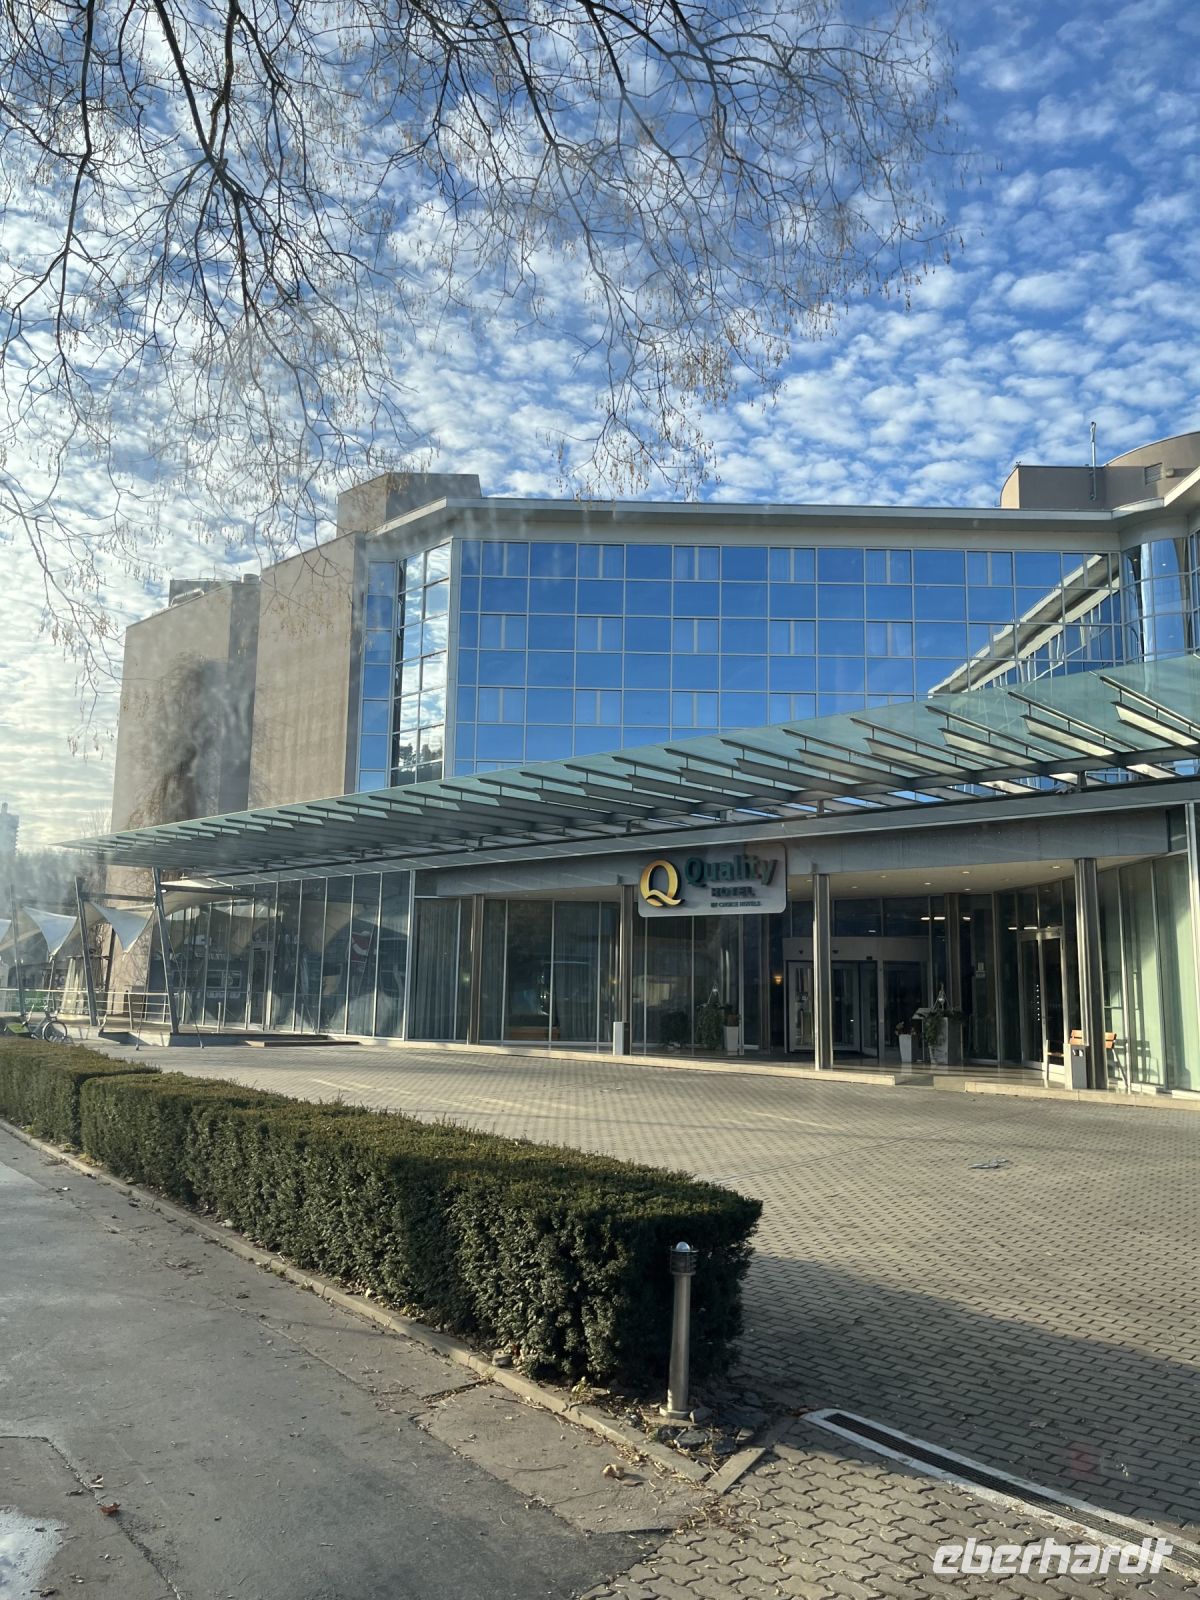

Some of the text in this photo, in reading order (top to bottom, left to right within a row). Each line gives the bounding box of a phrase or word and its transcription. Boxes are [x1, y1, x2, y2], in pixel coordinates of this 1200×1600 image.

[640, 859, 682, 907] Q
[685, 854, 777, 887] Quality
[711, 886, 754, 897] HOTEL
